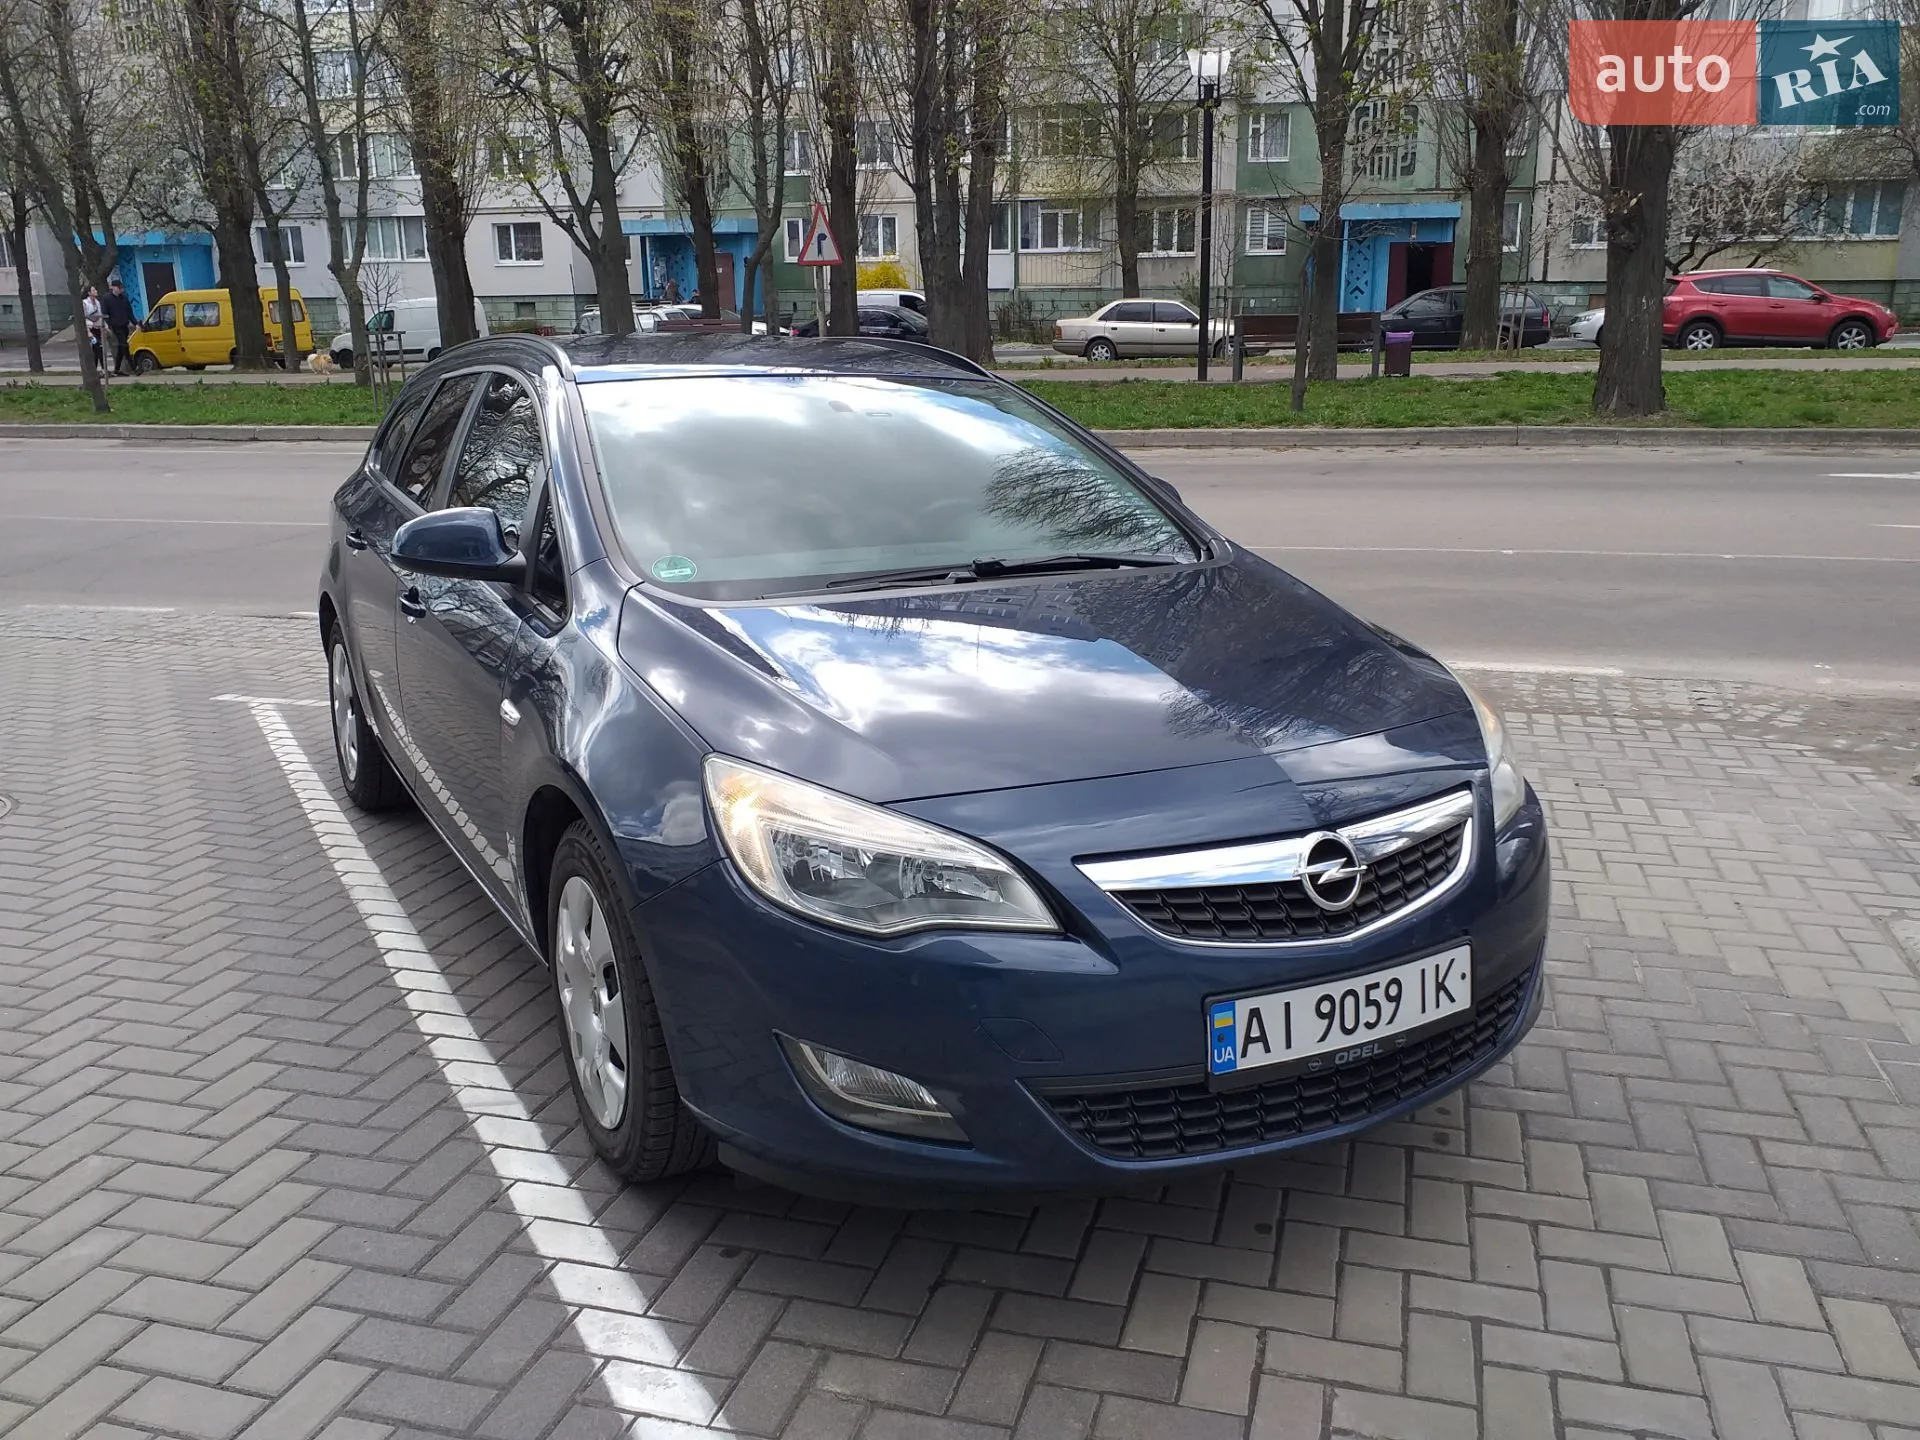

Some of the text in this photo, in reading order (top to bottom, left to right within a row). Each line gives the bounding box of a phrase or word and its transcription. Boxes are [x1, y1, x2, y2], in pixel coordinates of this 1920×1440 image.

[1240, 957, 1456, 1059] AI 9059 IK
[1213, 1045, 1235, 1064] UA
[1334, 1043, 1383, 1065] OPEL
